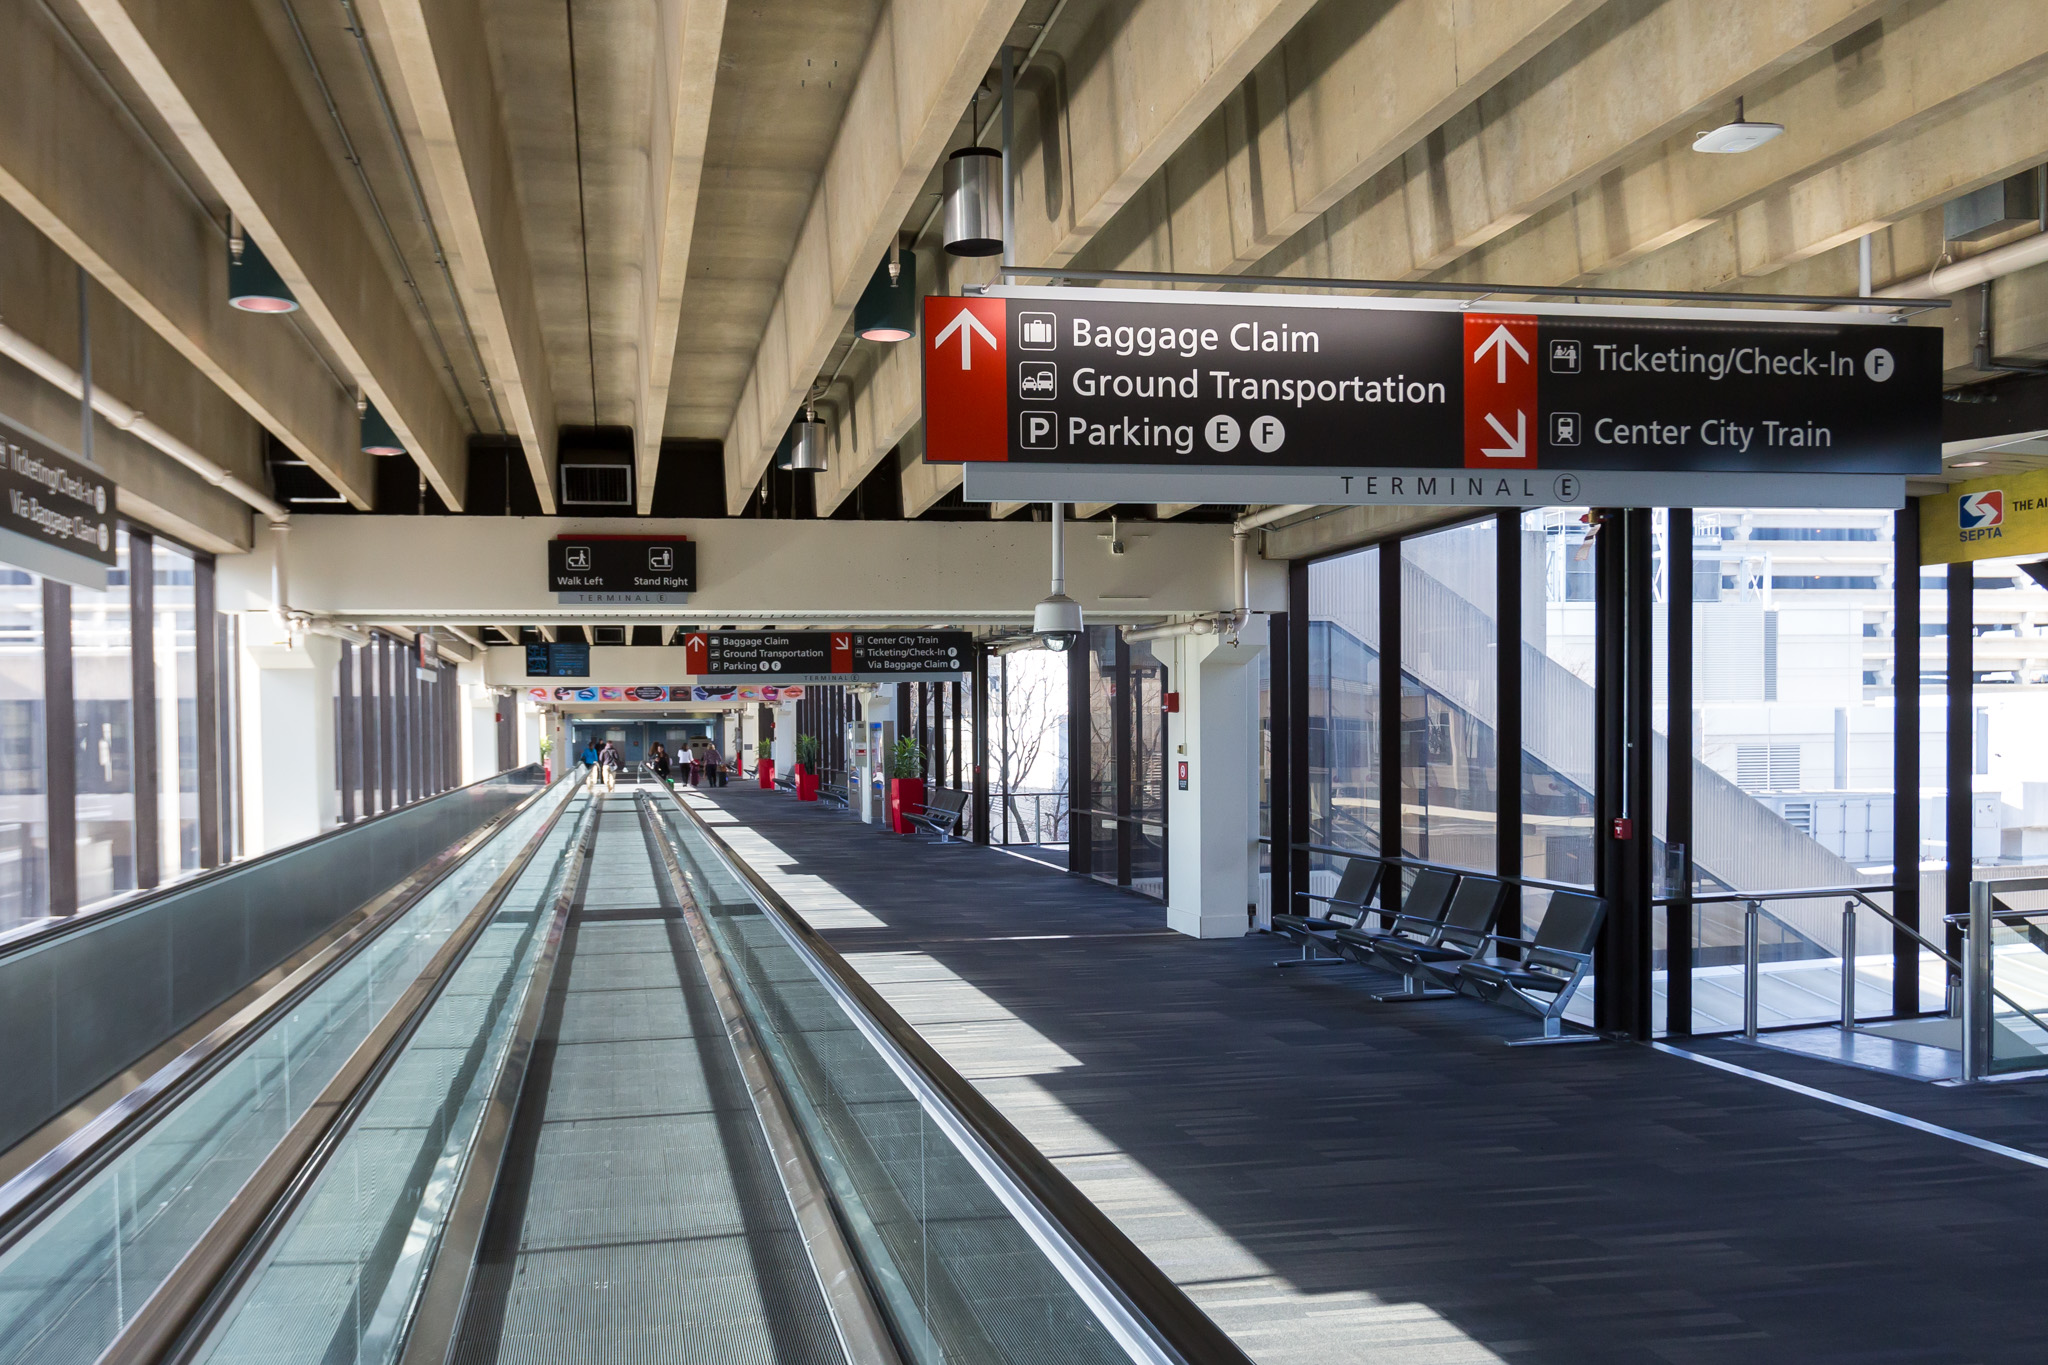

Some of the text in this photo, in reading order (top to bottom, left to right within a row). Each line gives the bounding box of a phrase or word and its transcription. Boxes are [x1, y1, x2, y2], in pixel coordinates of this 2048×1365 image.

[1073, 318, 1320, 358] Baggage Claim
[1592, 343, 1855, 381] Ticketing/Check-In
[1072, 367, 1446, 408] Ground Transportation
[1068, 415, 1195, 455] Parking
[1594, 417, 1832, 453] Center City Train
[1340, 476, 1534, 497] TERMINAL
[2012, 499, 2034, 512] THE
[29, 496, 74, 539] Baggage
[1960, 527, 2002, 542] SEPTA
[557, 576, 604, 586] Walk Left
[634, 576, 689, 588] Stand Right
[579, 594, 650, 602] TERMINAL
[723, 637, 789, 648] Baggage Claim
[867, 635, 939, 646] Center City Train
[723, 649, 824, 659] Ground Transportation
[868, 648, 946, 658] Ticketing/Check-In
[723, 661, 758, 672] Parking
[868, 660, 882, 669] Via
[884, 660, 922, 671] Baggage
[924, 660, 948, 668] Claim
